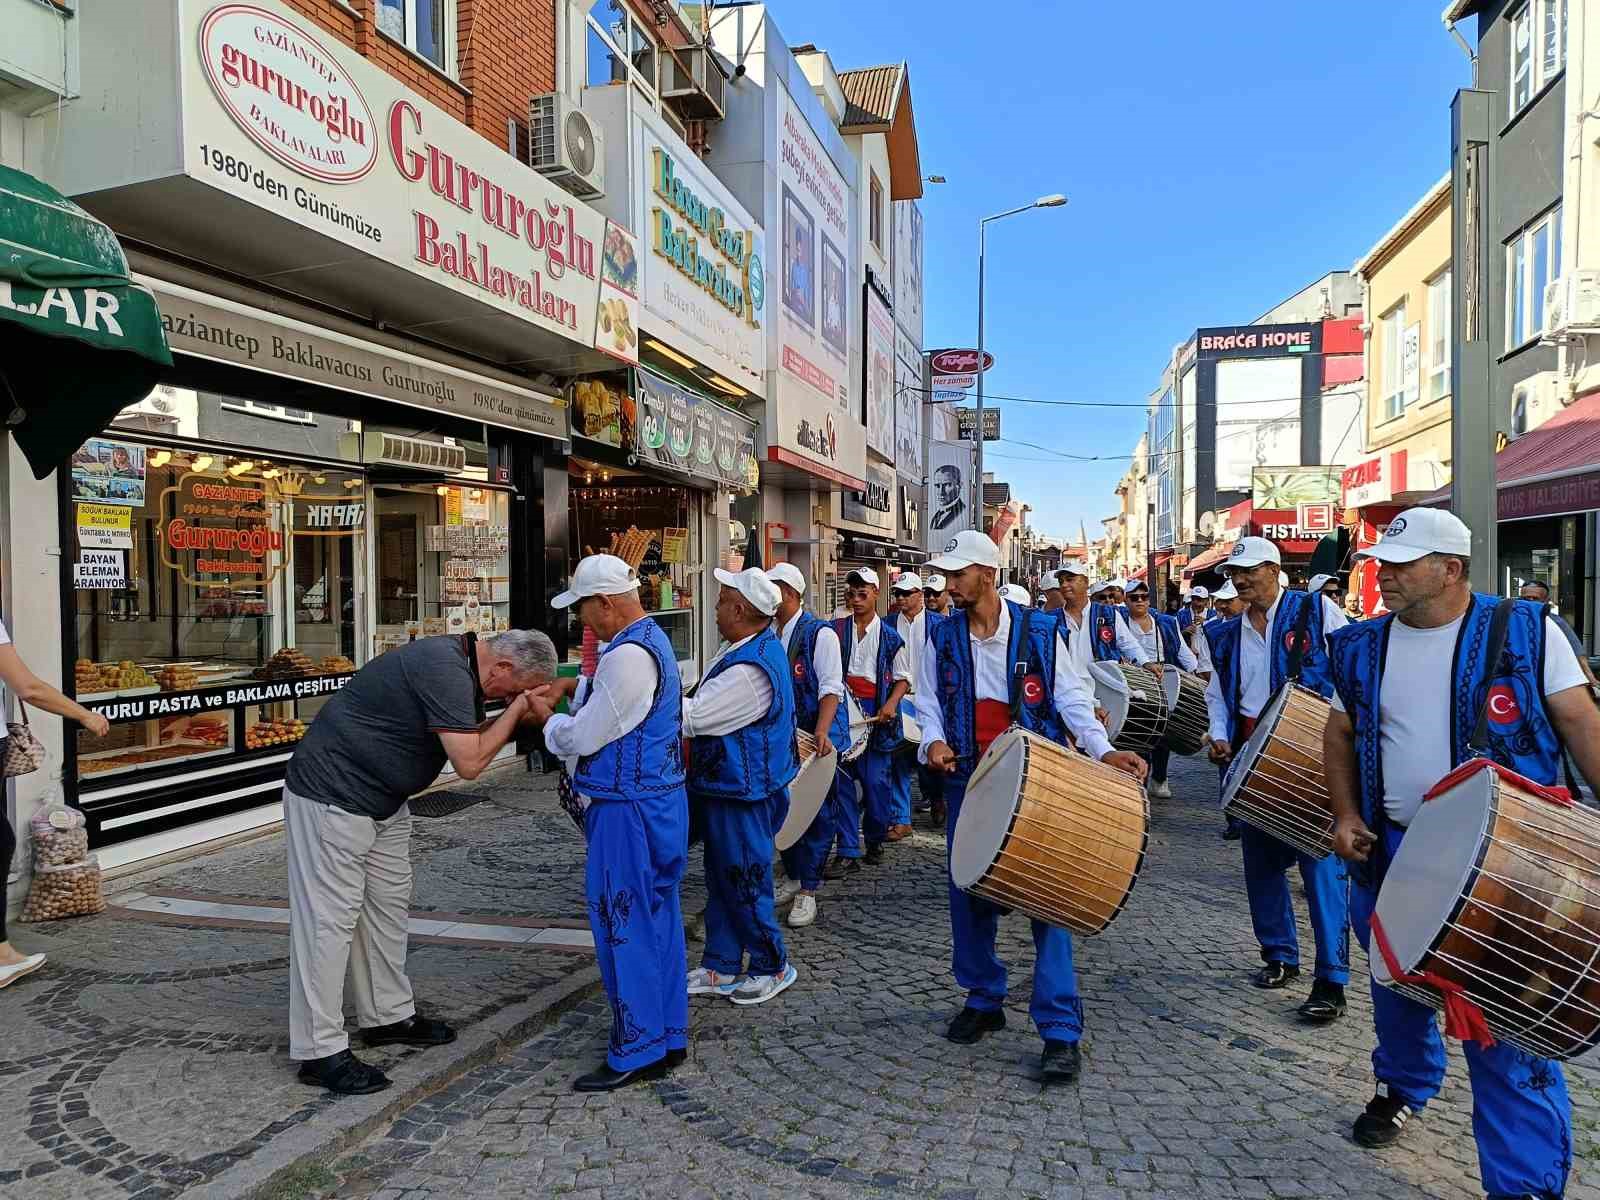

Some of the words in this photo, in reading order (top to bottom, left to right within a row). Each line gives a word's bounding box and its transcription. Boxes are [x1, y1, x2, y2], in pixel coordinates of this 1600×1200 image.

[254, 26, 337, 84] GAZİANTEP
[222, 43, 366, 146] gururoğlu
[250, 104, 346, 165] BAKLAVALARI
[200, 144, 288, 200] 1980'den
[294, 186, 382, 242] Günümüze
[389, 99, 596, 281] Gururoğlu
[413, 209, 578, 330] Baklavaları
[161, 312, 260, 360] aziantep
[271, 335, 373, 382] Baklavacısı
[382, 366, 456, 404] Gururoğlu
[1262, 331, 1312, 348] HOME
[168, 519, 283, 557] Gururoğlu
[1308, 508, 1325, 527] E
[74, 578, 125, 589] ARANIYOR
[80, 566, 120, 577] ELEMAN
[83, 554, 116, 565] BAYAN
[149, 695, 201, 715] PASTA
[205, 696, 222, 707] ve
[226, 685, 292, 705] BAKLAVA
